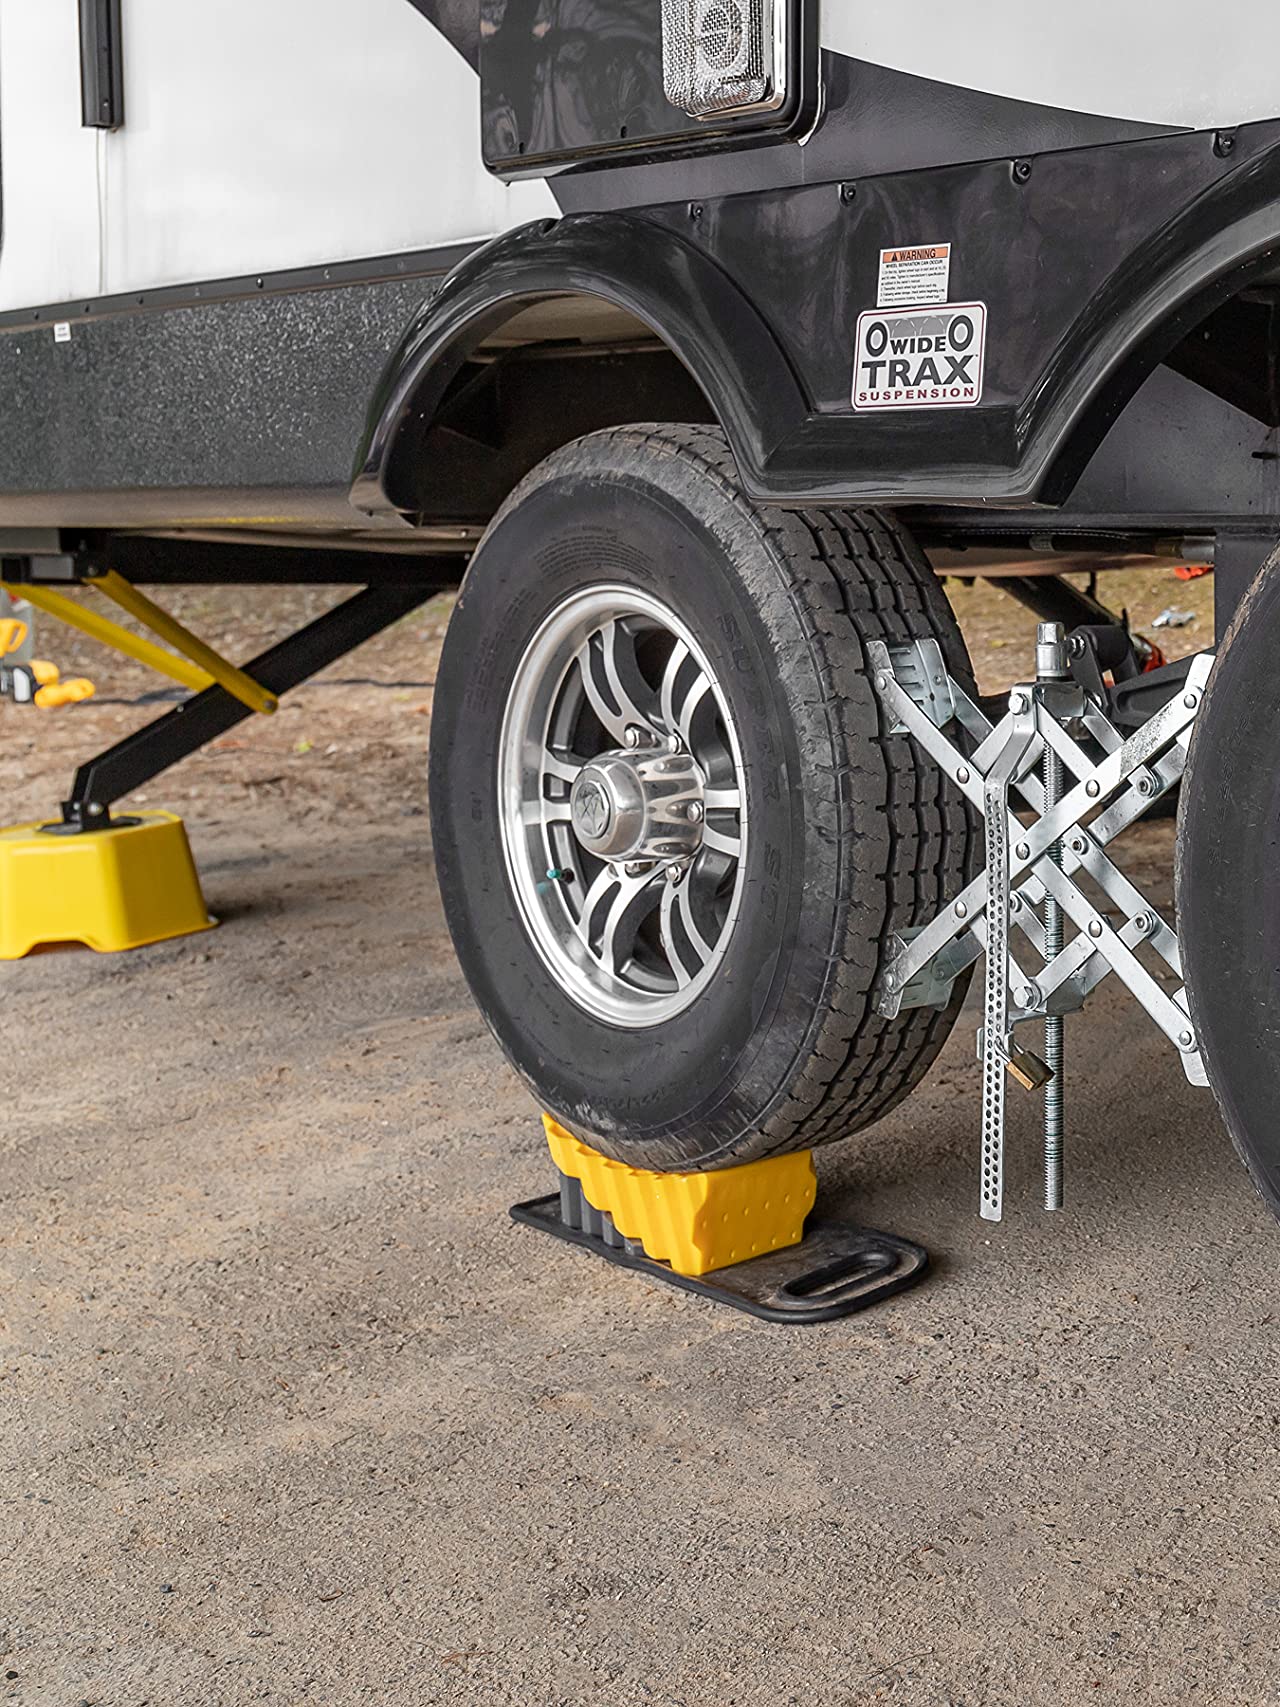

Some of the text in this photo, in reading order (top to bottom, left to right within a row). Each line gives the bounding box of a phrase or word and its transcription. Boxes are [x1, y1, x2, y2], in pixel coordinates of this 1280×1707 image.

[900, 248, 937, 260] WARNING
[890, 336, 946, 355] WIDE
[862, 354, 974, 389] TRAX
[859, 387, 974, 402] SUSPENSION
